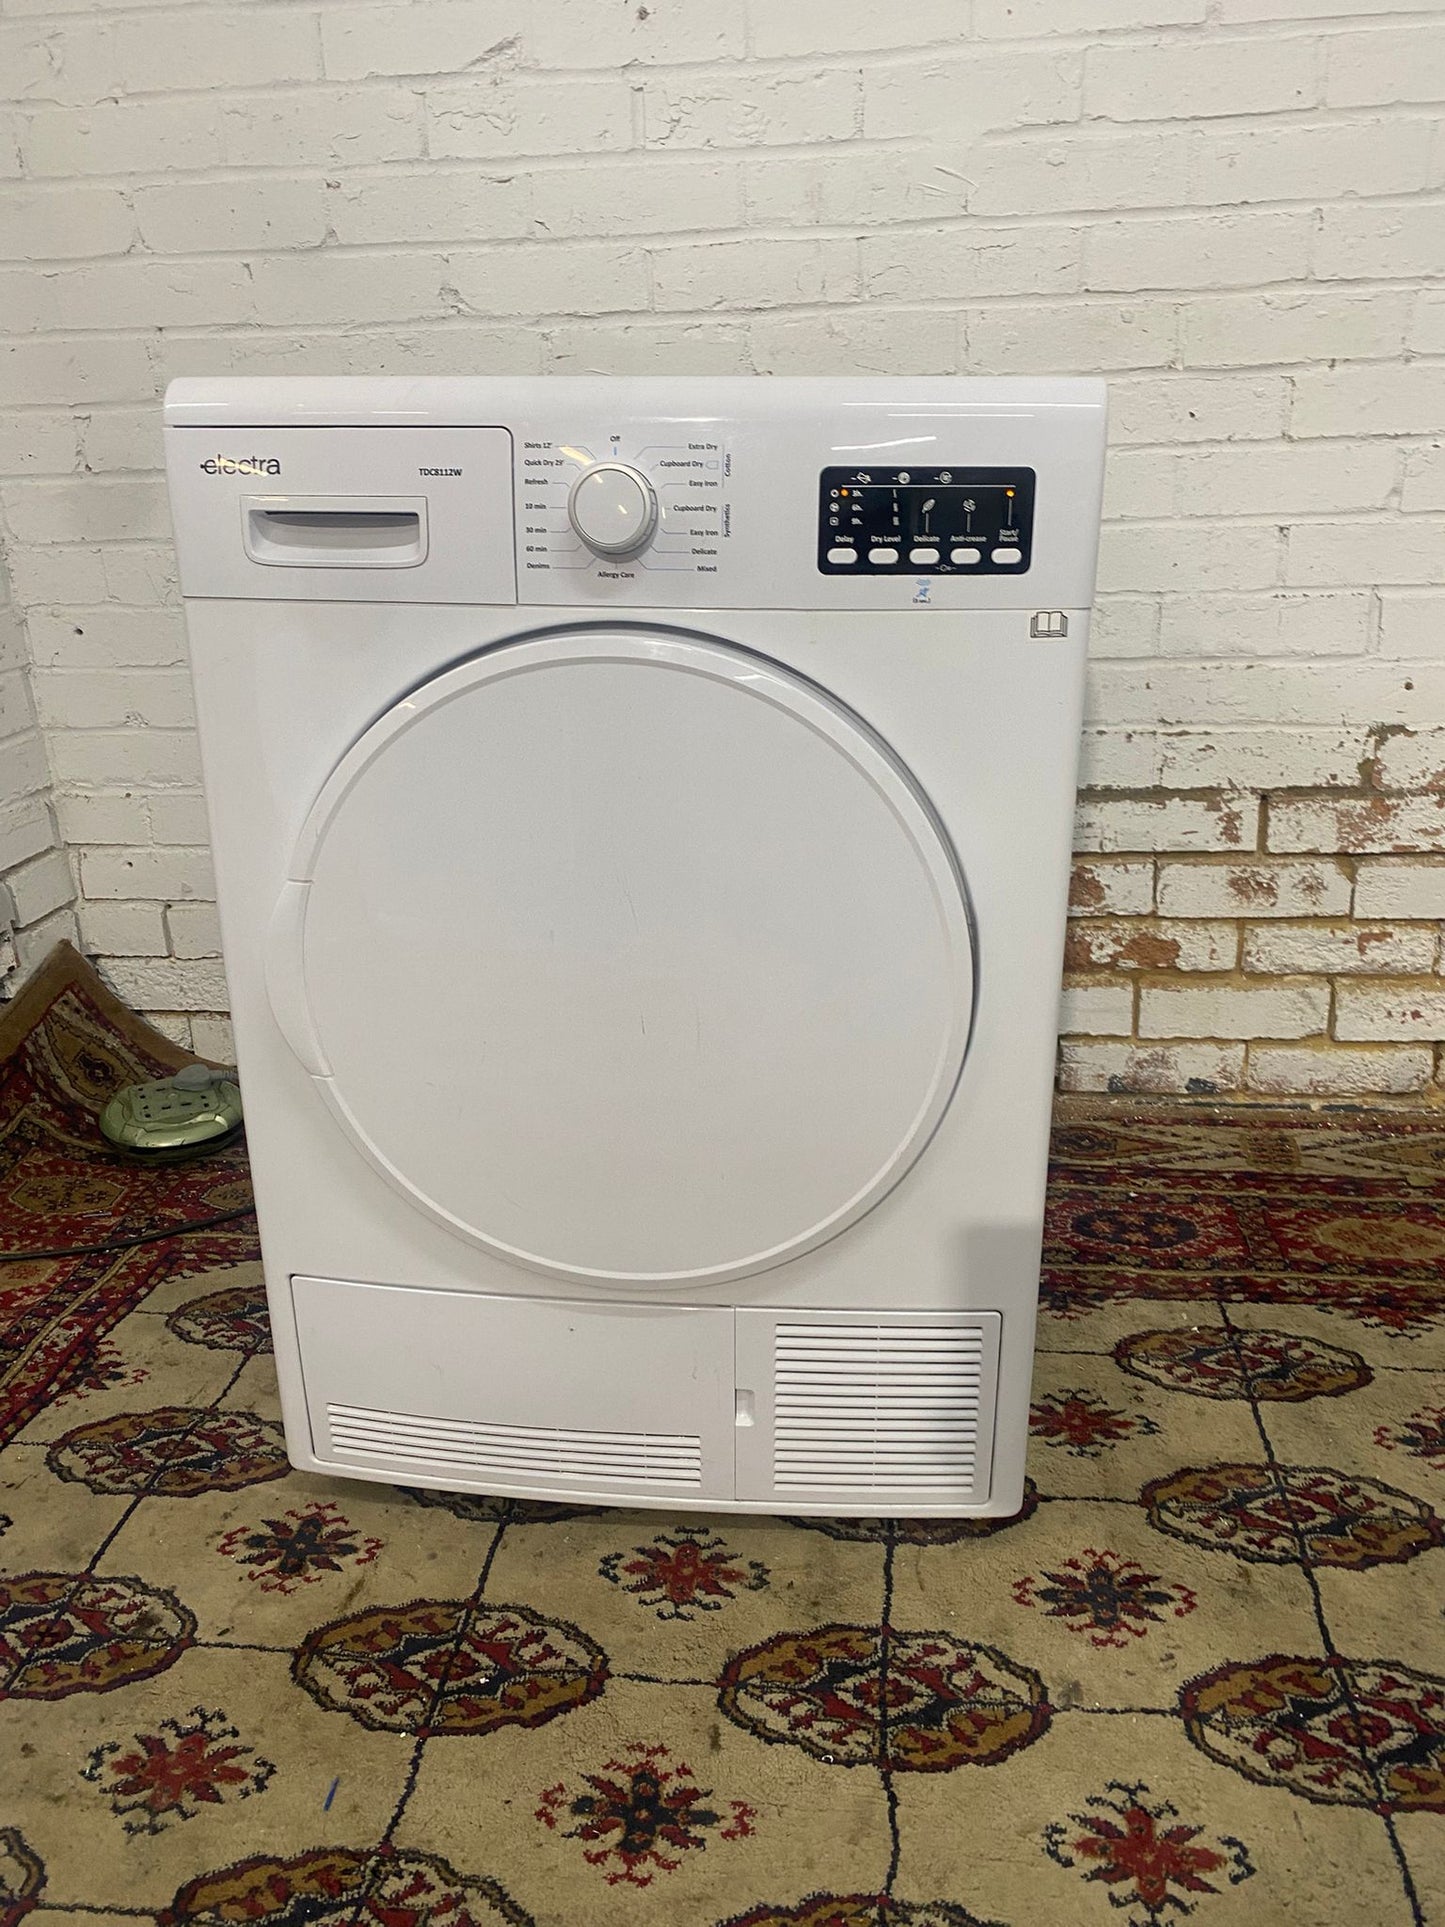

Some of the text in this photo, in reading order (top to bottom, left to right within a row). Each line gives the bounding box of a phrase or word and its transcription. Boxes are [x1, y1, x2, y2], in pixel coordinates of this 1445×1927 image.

[706, 443, 718, 451] Dry
[202, 453, 281, 475] electra
[524, 459, 542, 467] Quick
[543, 459, 554, 467] Dry
[660, 460, 704, 468] Cupboard Dry
[419, 468, 463, 477] TDC8112W
[689, 480, 704, 488] Easy
[705, 505, 717, 513] Dry
[690, 529, 704, 537] Easy
[835, 535, 854, 543] Delay
[870, 535, 883, 543] Dry
[598, 571, 619, 579] Allergy
